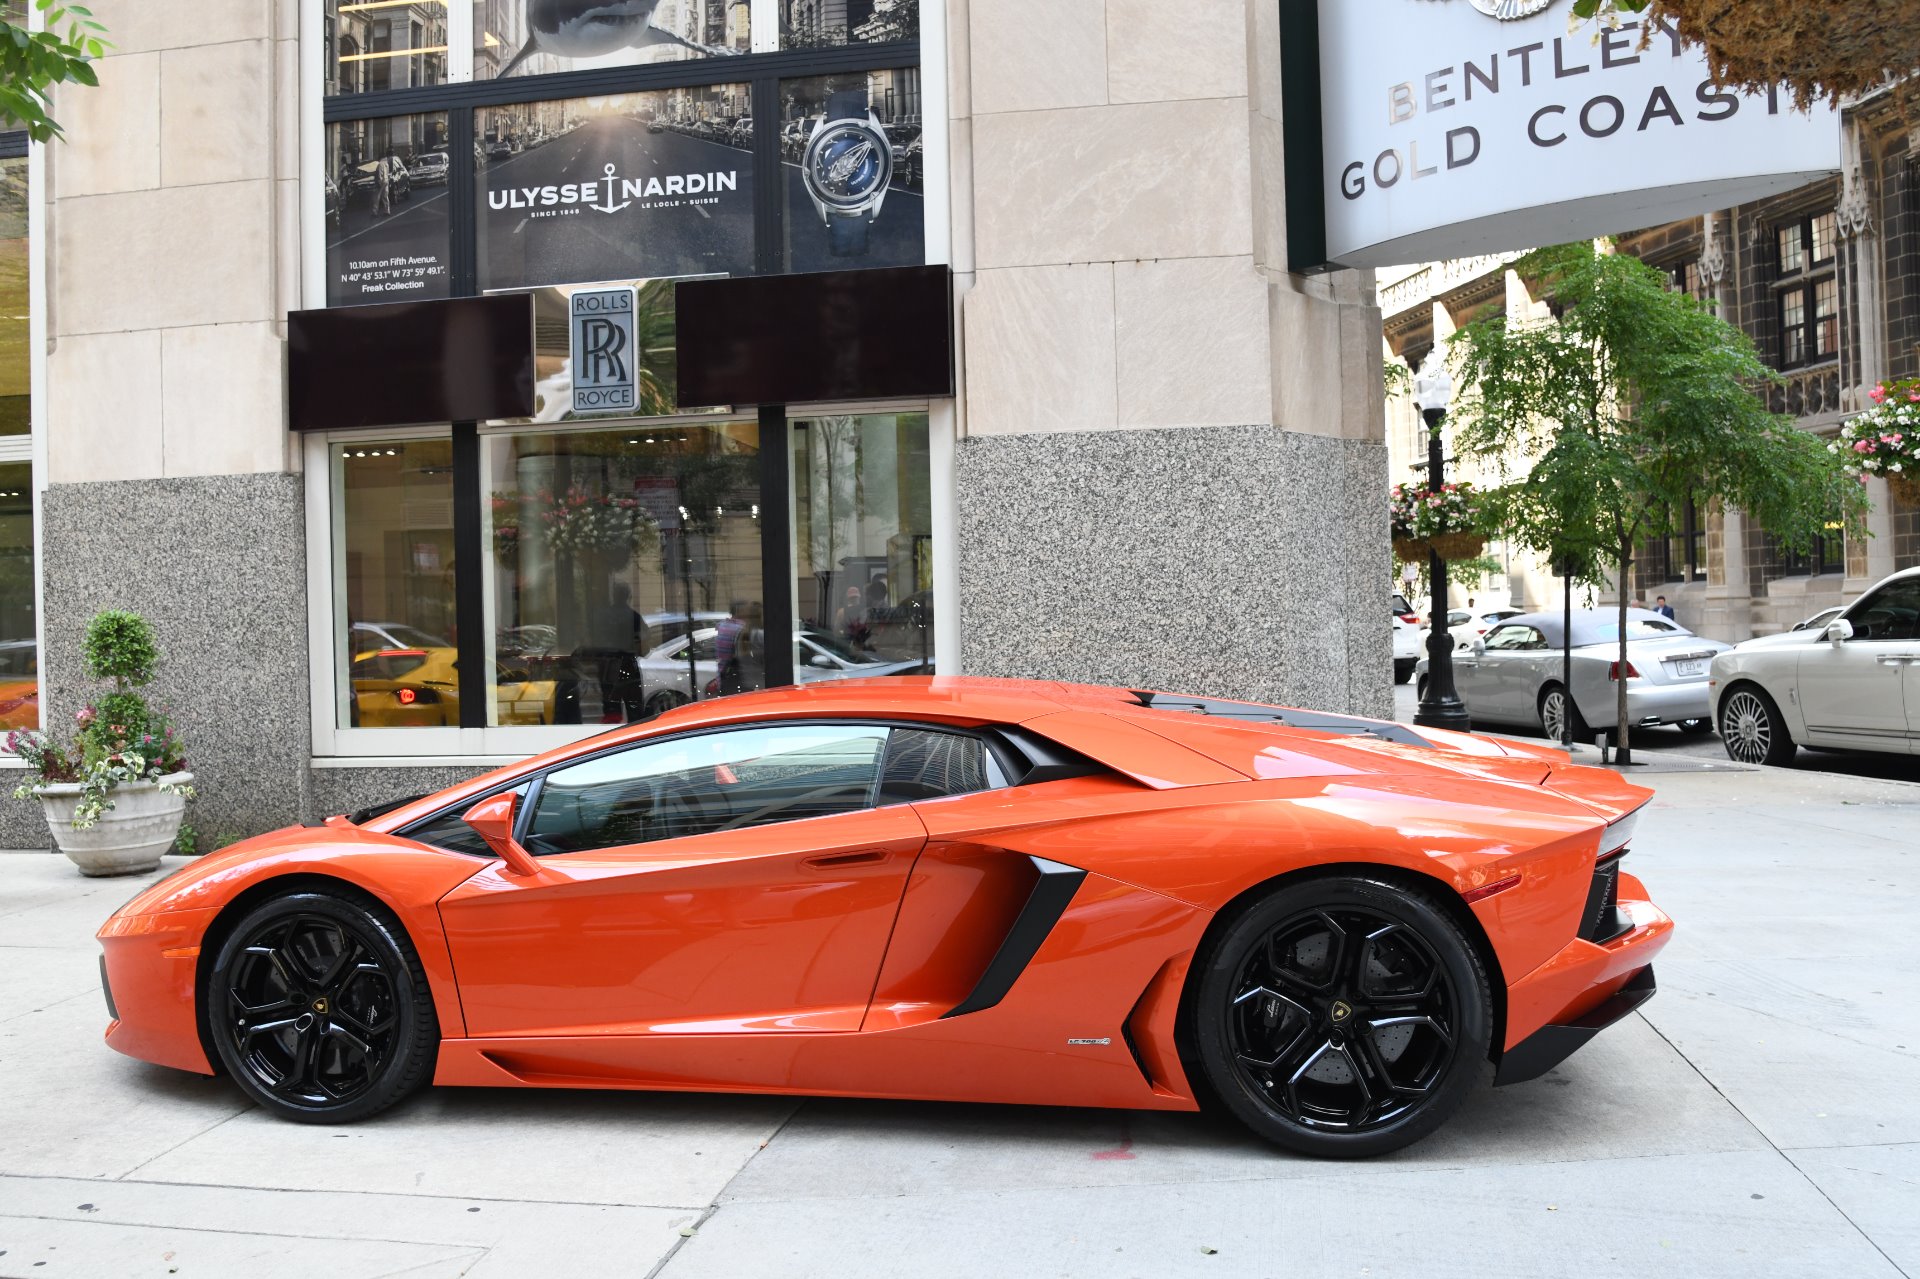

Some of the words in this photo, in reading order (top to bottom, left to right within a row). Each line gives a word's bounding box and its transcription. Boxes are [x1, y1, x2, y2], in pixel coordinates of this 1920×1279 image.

[1339, 125, 1482, 201] GOLD
[488, 181, 598, 210] ULYSSE
[621, 170, 737, 199] NARDIN
[654, 200, 680, 208] LOCLE
[689, 197, 719, 205] SUISSE
[530, 210, 557, 218] SINCE
[349, 260, 378, 270] 10.10am
[378, 259, 389, 268] on
[390, 256, 407, 267] Fifth
[408, 255, 438, 265] Avenue.
[341, 274, 348, 283] N
[391, 269, 401, 278] W
[361, 283, 384, 293] Freak
[384, 280, 425, 291] Collection
[576, 294, 629, 312] ROLLS
[577, 389, 630, 405] ROYCE
